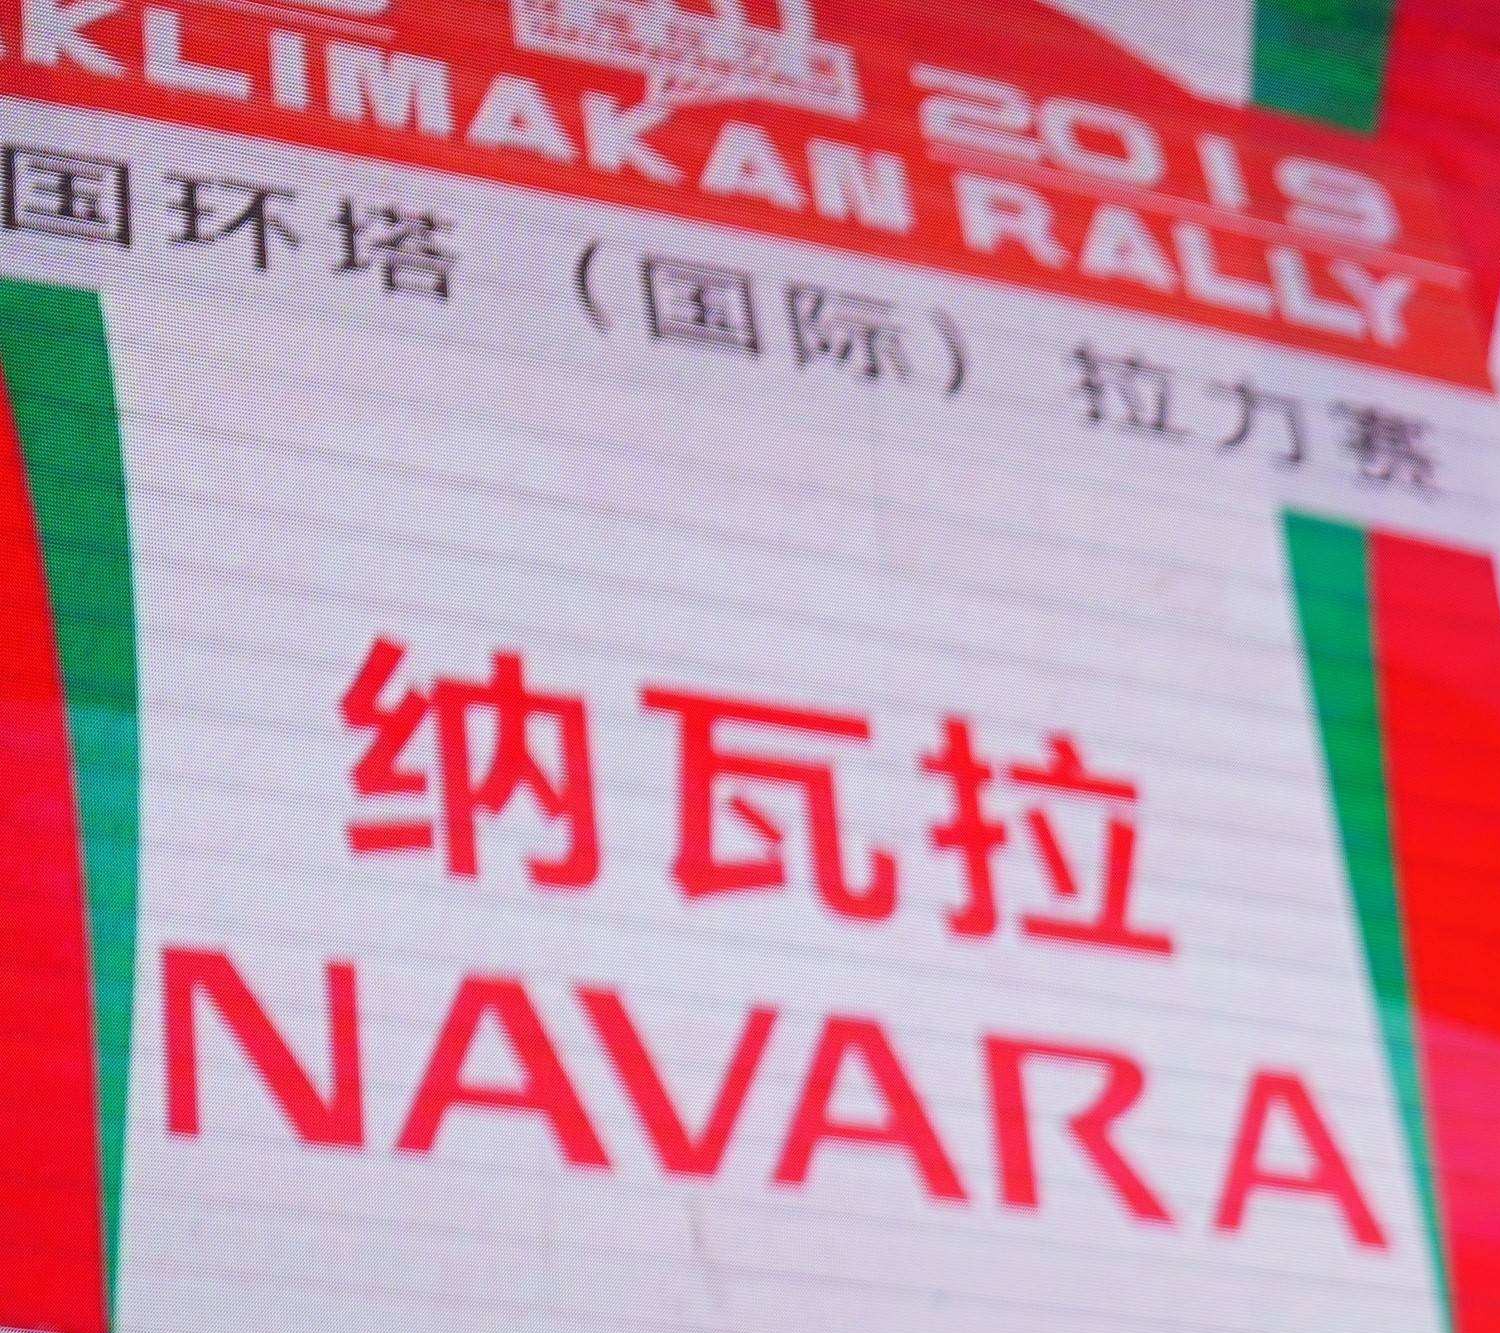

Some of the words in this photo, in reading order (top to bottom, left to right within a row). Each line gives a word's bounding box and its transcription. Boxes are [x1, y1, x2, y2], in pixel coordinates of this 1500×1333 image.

[0, 0, 911, 236] KLIMAKAN
[950, 173, 1430, 349] RALLY
[911, 64, 1398, 246] 2019
[340, 633, 1176, 957] 纳瓦拉
[158, 943, 1392, 1253] NAVARA
